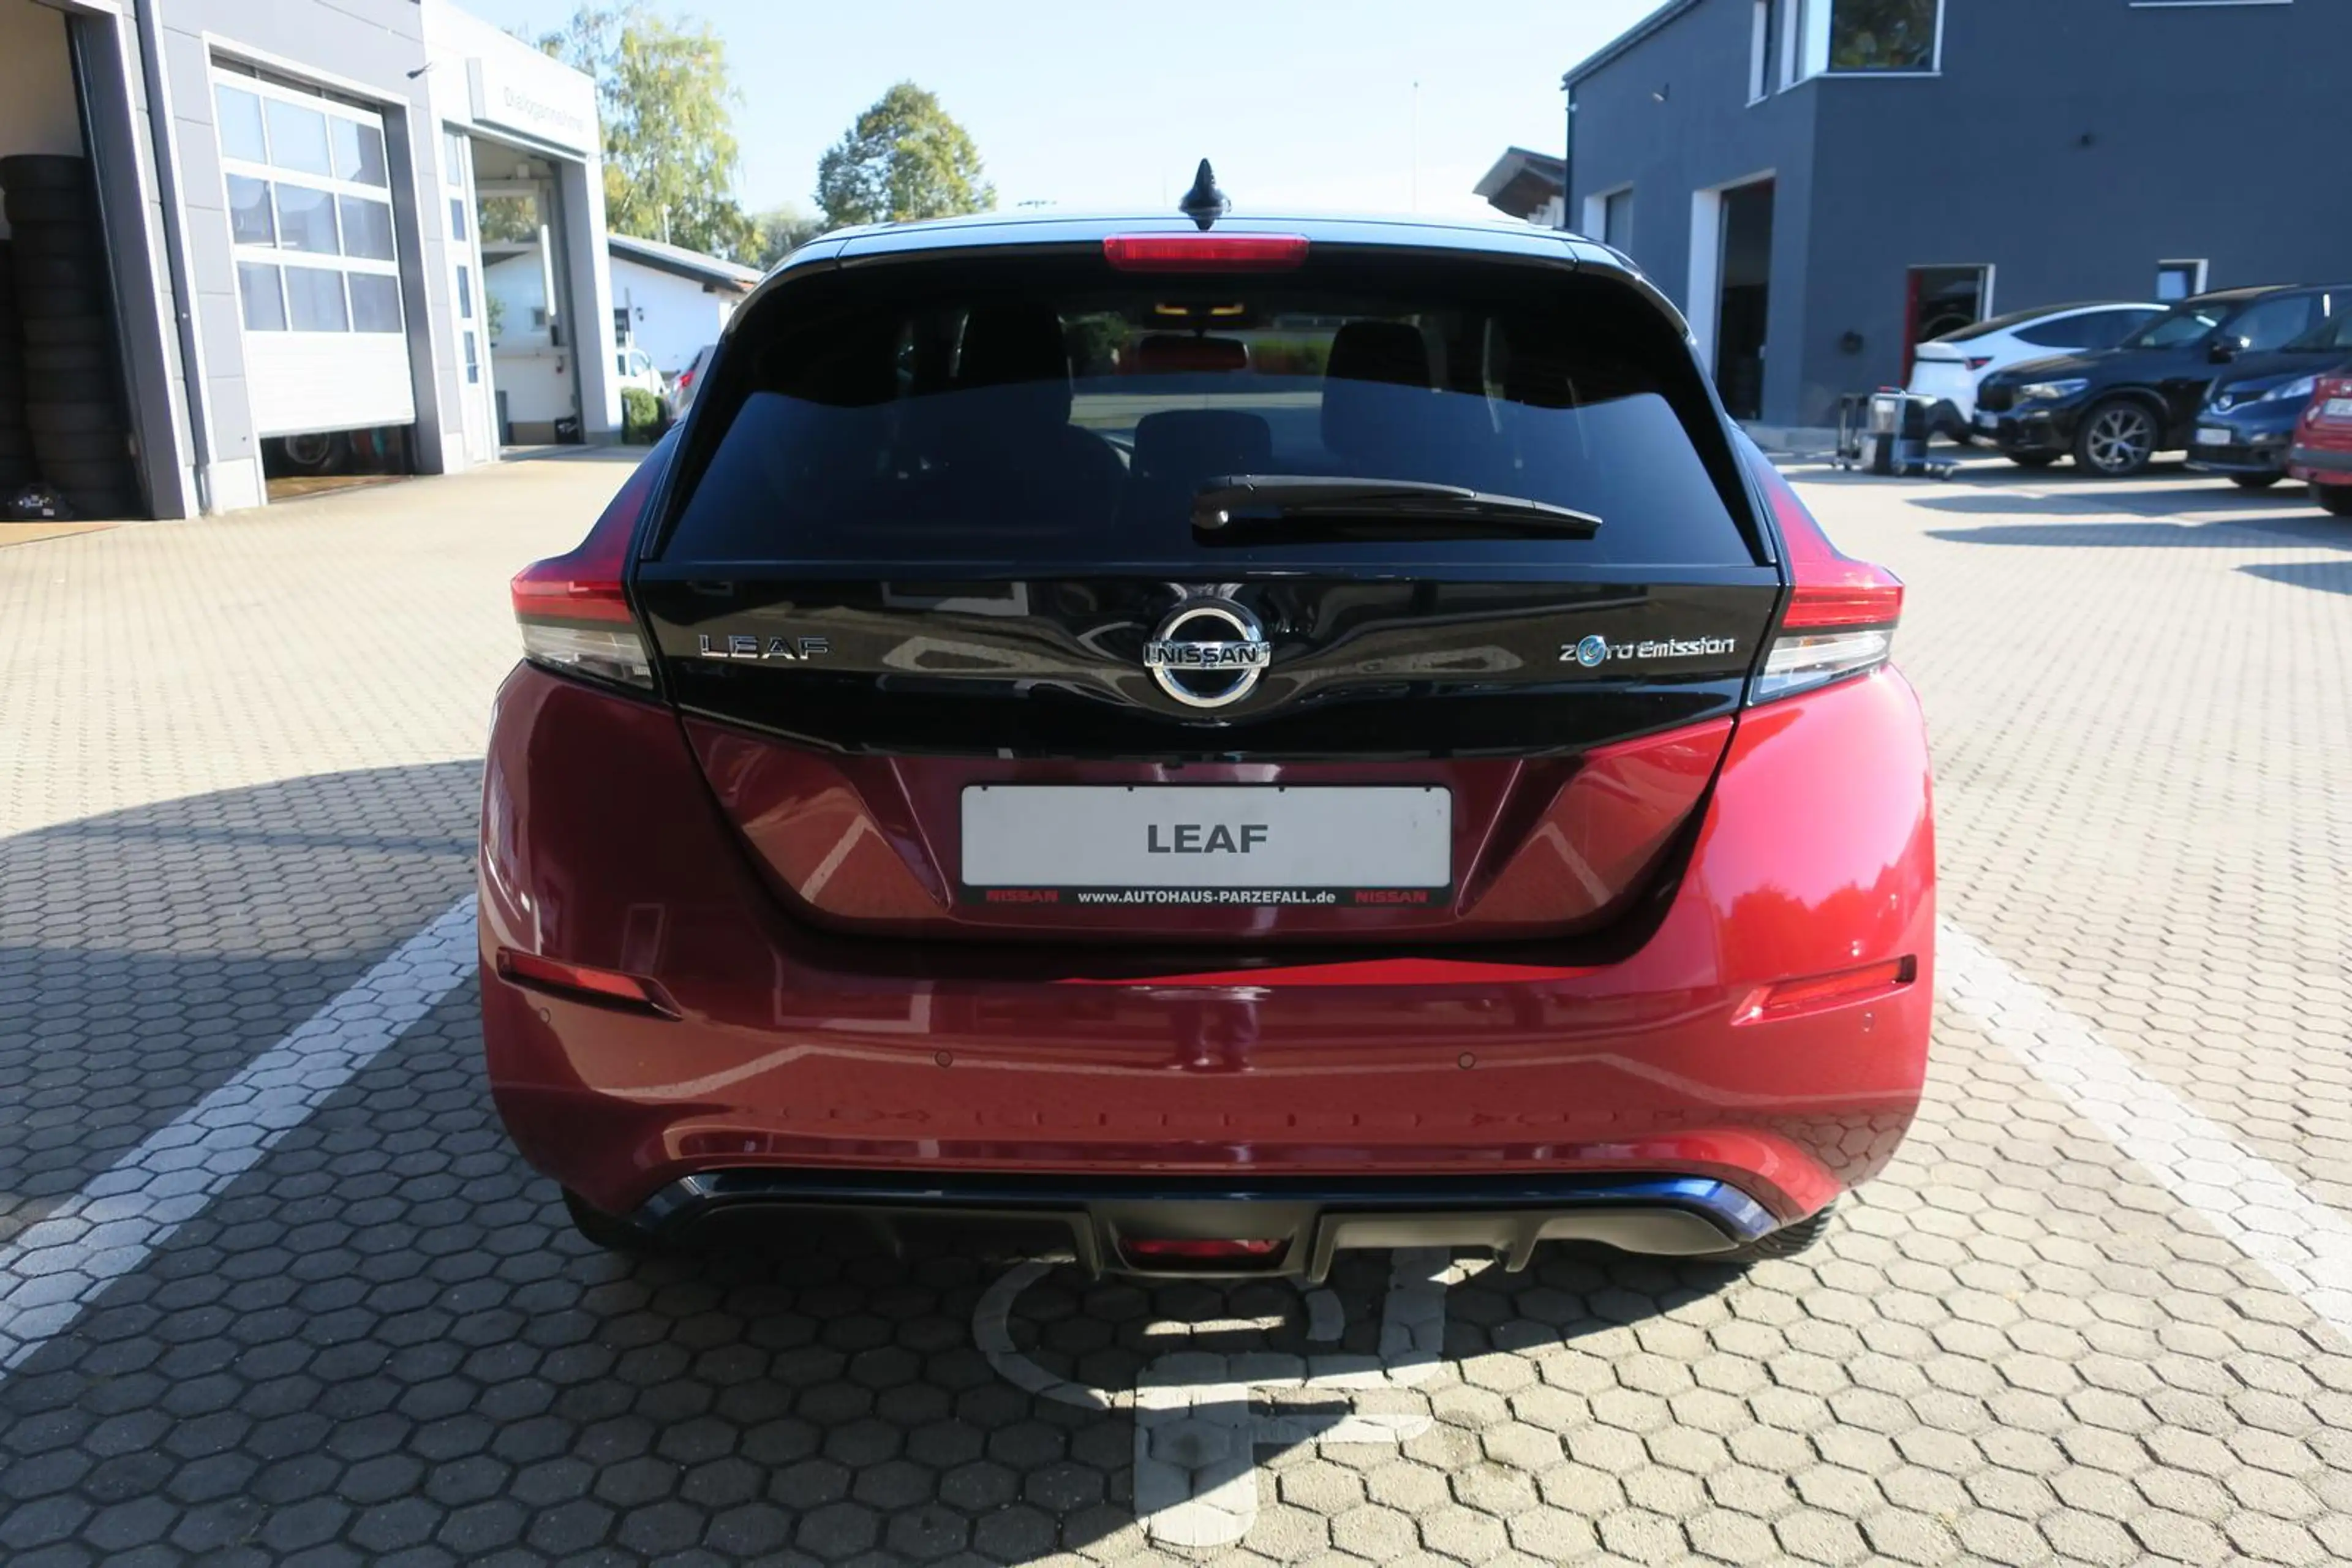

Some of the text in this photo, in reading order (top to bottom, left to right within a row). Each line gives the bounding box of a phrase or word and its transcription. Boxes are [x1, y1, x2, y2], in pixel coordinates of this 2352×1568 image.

[699, 635, 829, 660] LEAF
[1158, 647, 1257, 663] NISSAN
[1148, 824, 1268, 853] LEAF
[986, 890, 1058, 902] NISSAN
[1355, 891, 1428, 903] NISSAN
